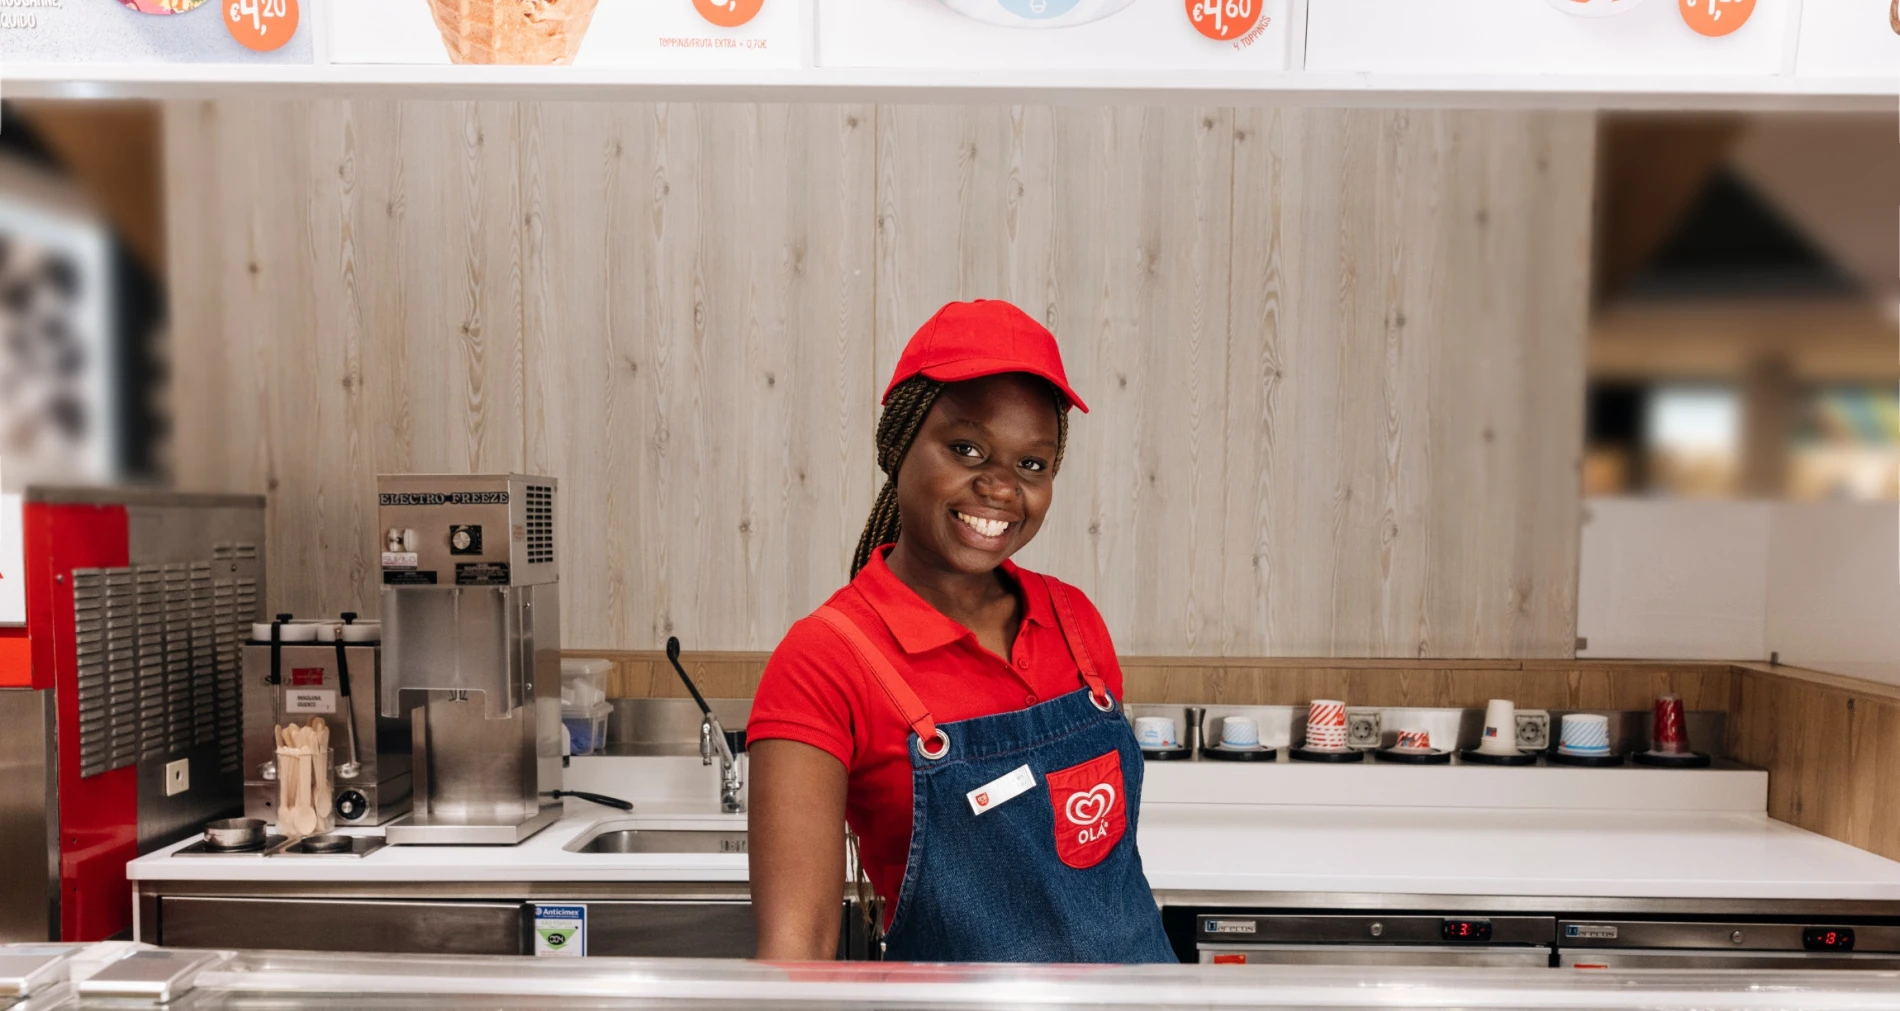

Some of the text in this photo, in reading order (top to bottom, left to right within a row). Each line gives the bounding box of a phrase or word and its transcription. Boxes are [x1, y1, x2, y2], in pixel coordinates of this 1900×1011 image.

[1233, 15, 1271, 51] 4 TOPPINGS
[714, 38, 737, 48] EXTRA
[380, 492, 509, 505] ELECTRO FREEZE
[543, 908, 579, 916] Anticimex
